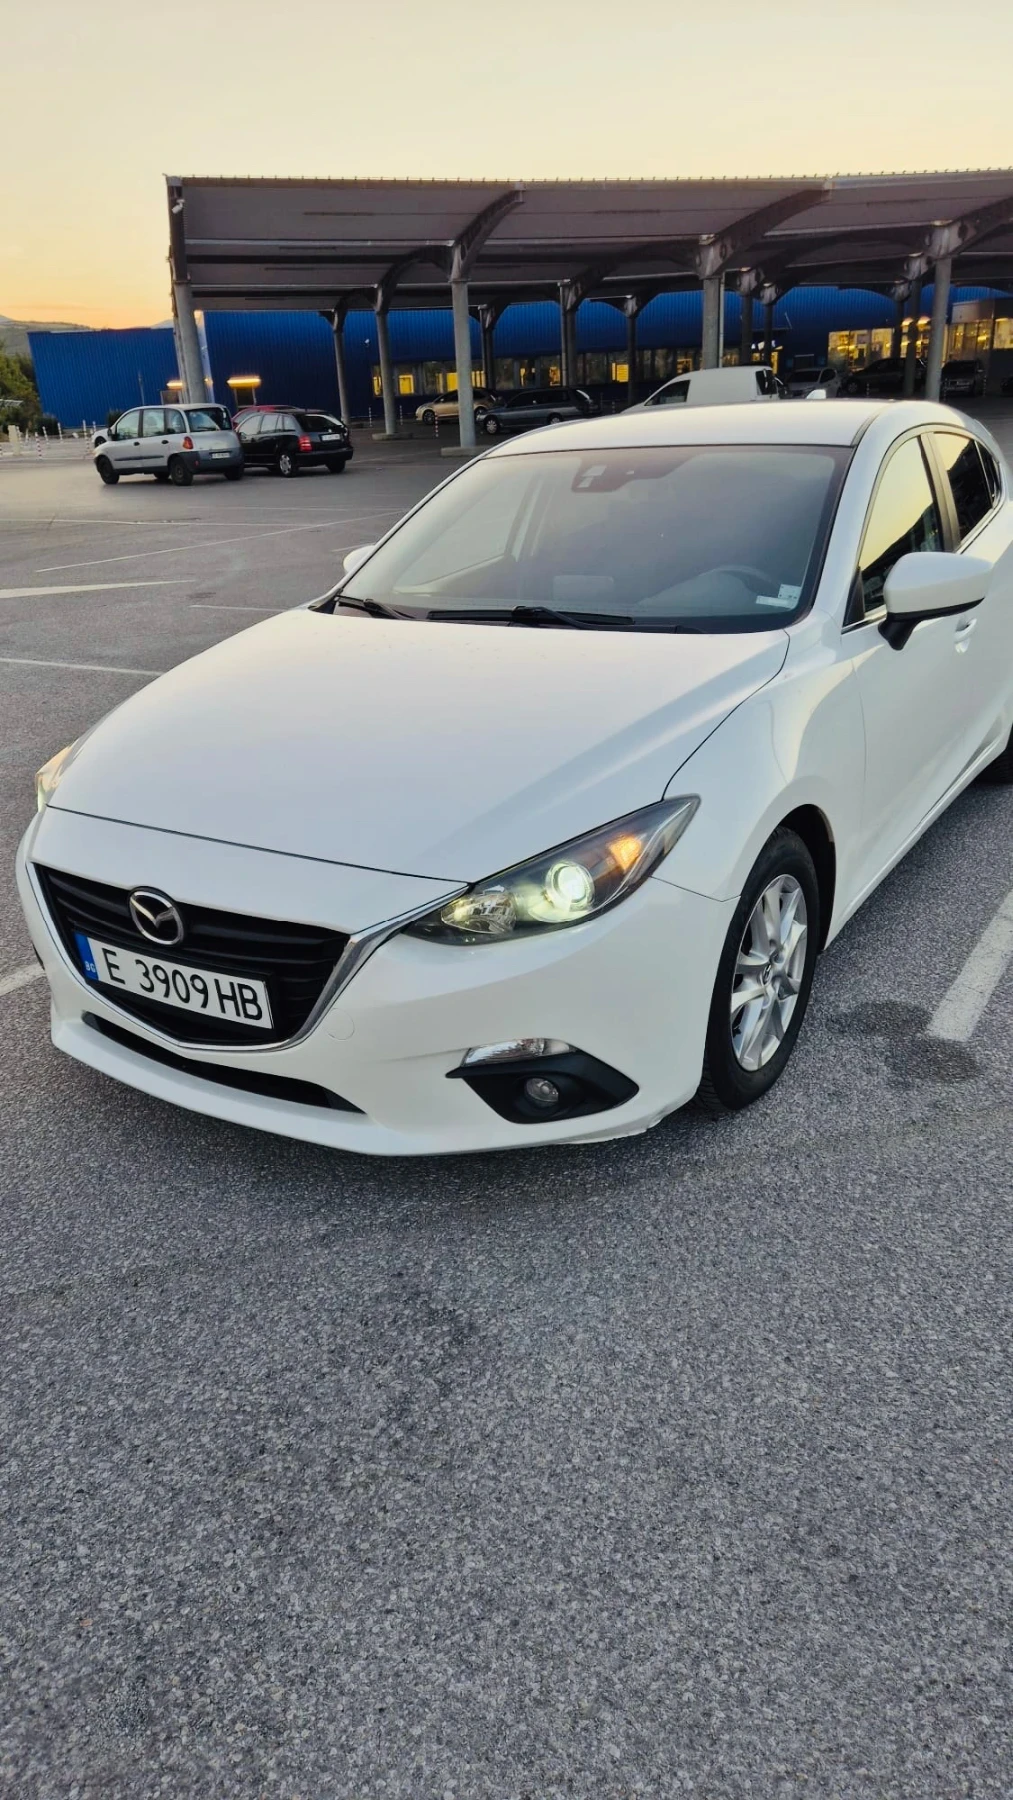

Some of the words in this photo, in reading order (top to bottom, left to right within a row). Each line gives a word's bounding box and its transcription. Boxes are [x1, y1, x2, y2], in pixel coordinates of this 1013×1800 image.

[102, 947, 125, 984] E
[135, 959, 208, 1009] 3909
[214, 978, 262, 1020] HB
